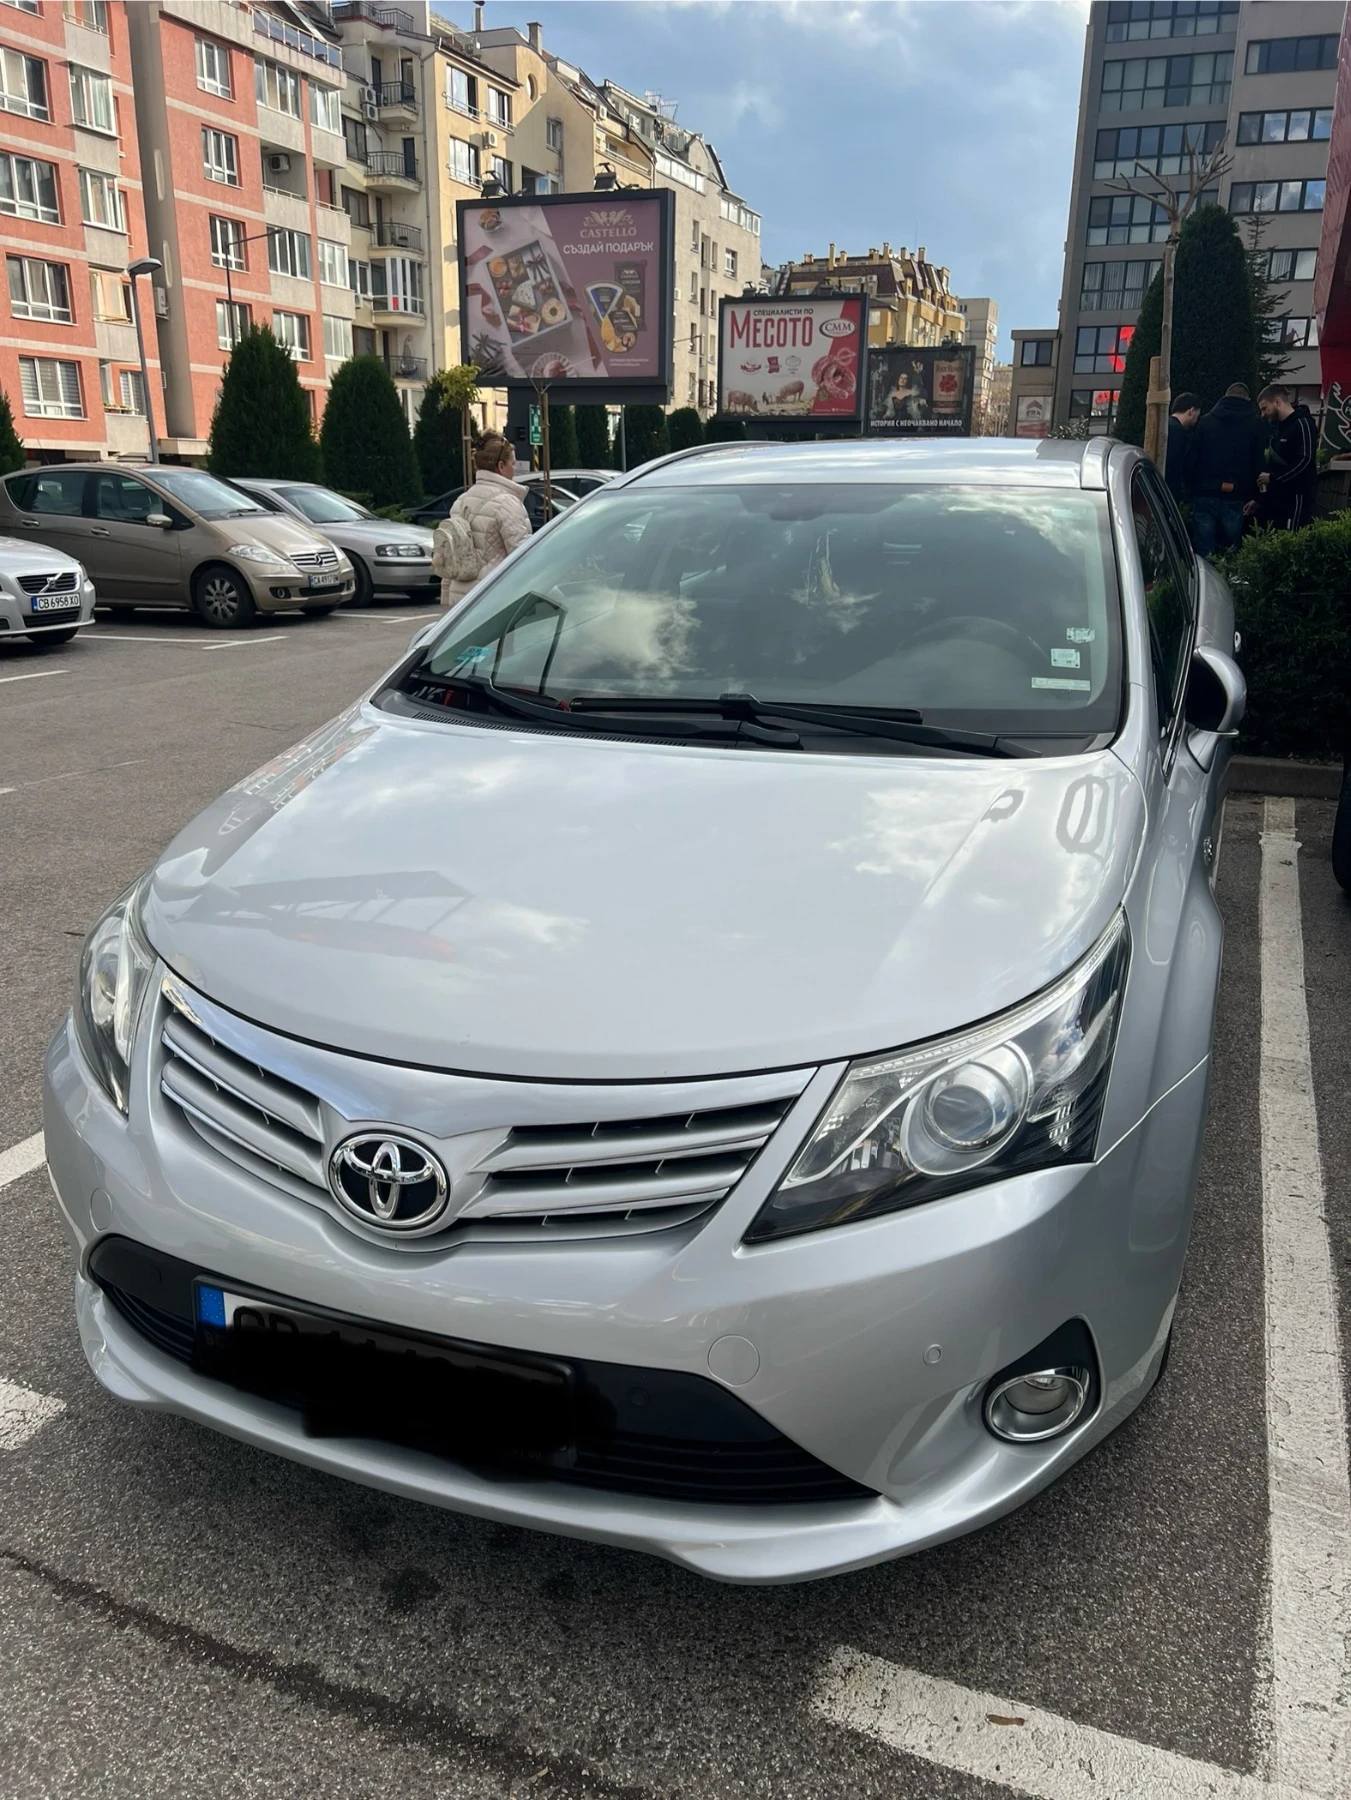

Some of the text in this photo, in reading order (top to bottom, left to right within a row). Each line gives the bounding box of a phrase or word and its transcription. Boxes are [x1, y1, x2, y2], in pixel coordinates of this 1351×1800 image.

[580, 227, 637, 239] CASTELLO
[563, 241, 654, 255] СЪЗДАЙ ПОДАРЪК
[753, 308, 802, 317] СПЕЦИАЛИСТИ
[730, 309, 814, 349] МЕСОТО
[870, 419, 896, 427] ИСТОРИЯ
[900, 419, 938, 427] НЕОЧАКВАНО
[939, 419, 963, 427] НАЧАЛО
[38, 595, 79, 610] CB 6958 XO
